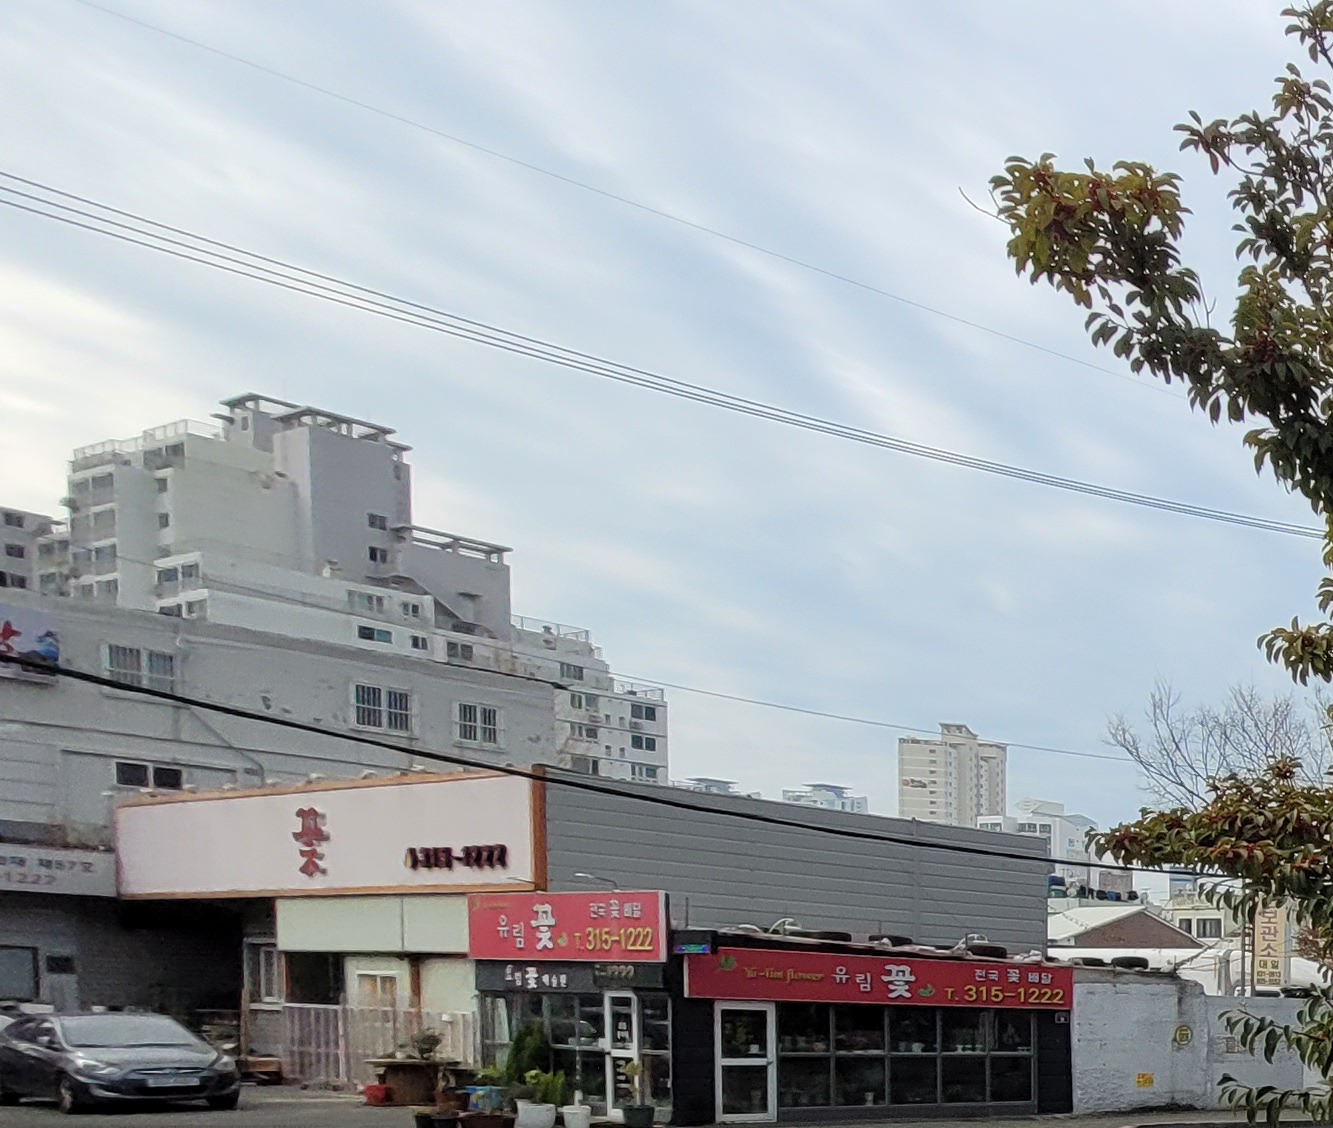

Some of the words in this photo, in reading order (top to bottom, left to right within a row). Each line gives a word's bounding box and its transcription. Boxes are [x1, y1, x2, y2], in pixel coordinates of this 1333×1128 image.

[292, 807, 331, 876] 꽃
[530, 903, 556, 950] 꽃
[586, 927, 654, 950] 315-1222
[832, 966, 871, 992] 유림
[881, 964, 916, 999] 꽃
[974, 969, 999, 982] 전국
[1007, 968, 1021, 983] 꽃
[1028, 972, 1053, 985] 배달
[964, 984, 1065, 1004] 315-1222
